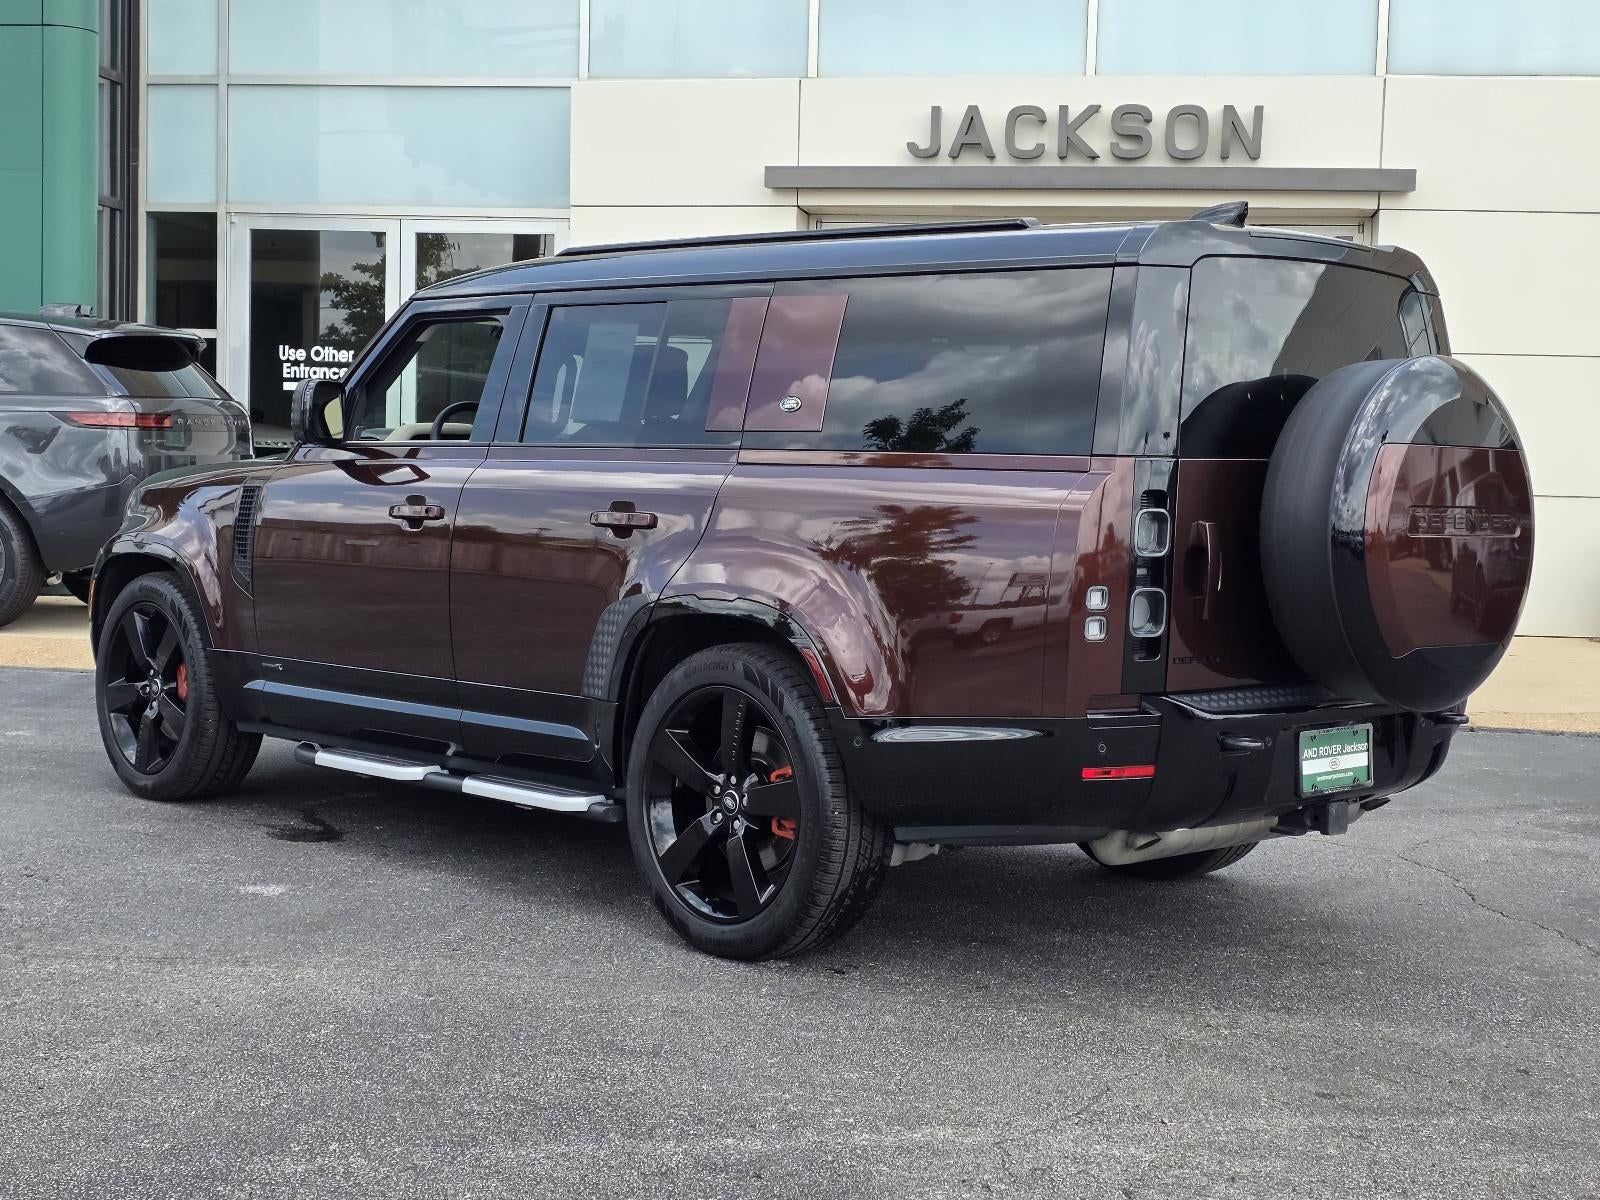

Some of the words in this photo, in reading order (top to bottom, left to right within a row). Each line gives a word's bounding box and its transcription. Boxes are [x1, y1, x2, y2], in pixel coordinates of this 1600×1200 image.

[906, 104, 1264, 160] JACKSON
[279, 345, 307, 361] Use
[310, 345, 355, 362] Other
[1416, 512, 1514, 531] DEFENDER
[1303, 747, 1318, 758] AND
[1319, 744, 1342, 757] ROVER
[1343, 742, 1368, 754] Jackson
